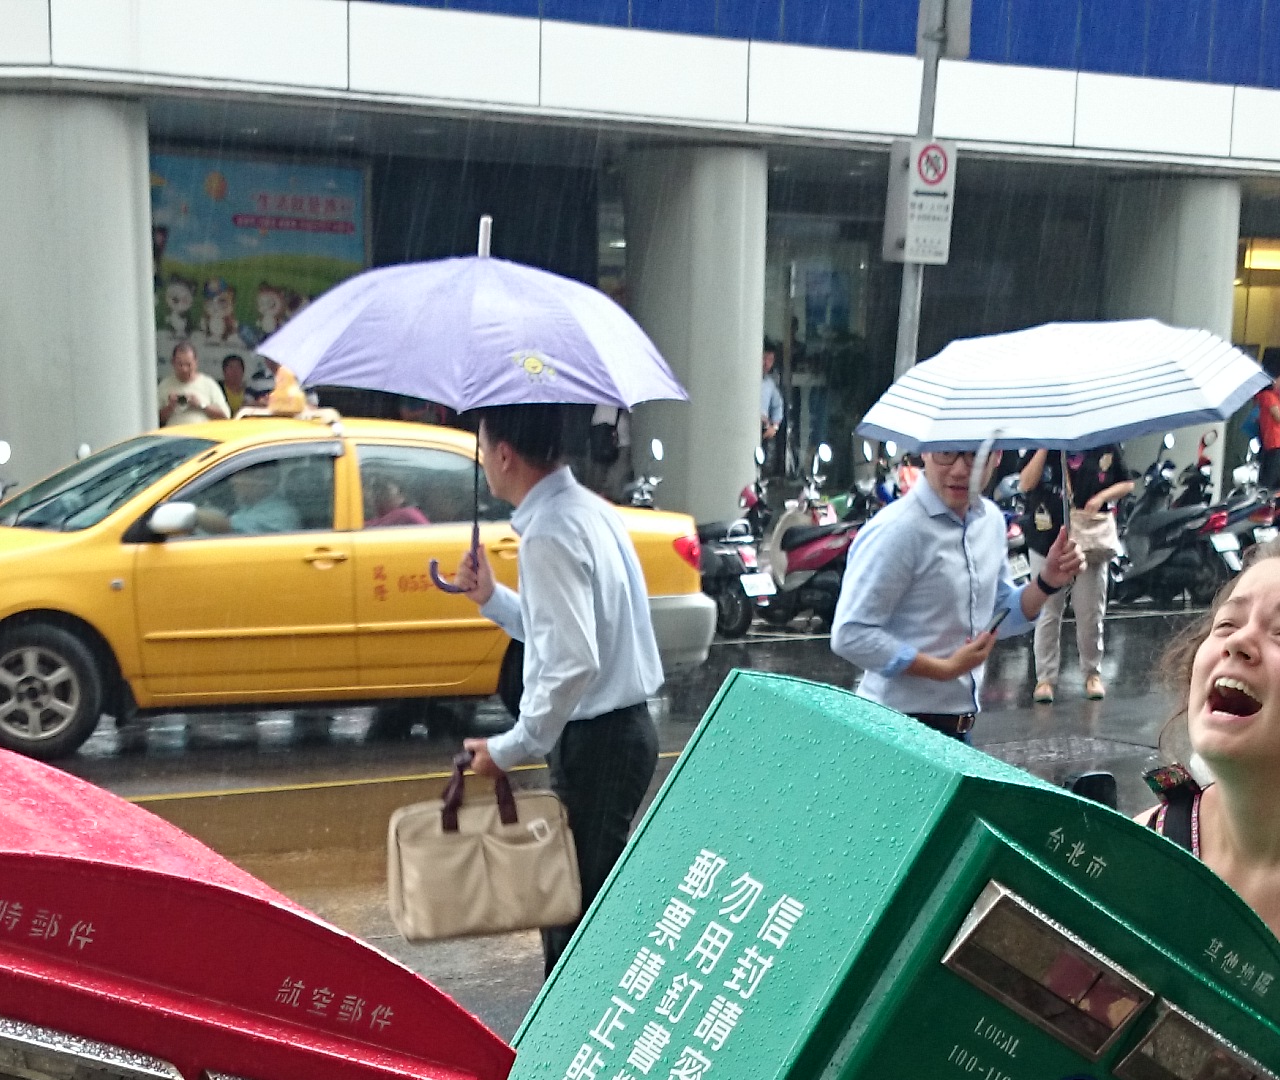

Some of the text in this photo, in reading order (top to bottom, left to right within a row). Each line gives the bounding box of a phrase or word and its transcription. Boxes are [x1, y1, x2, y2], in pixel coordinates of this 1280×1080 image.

[1046, 827, 1109, 880] 台北市
[1204, 936, 1274, 997] 其他地區
[275, 977, 394, 1031] 航空郵件
[975, 1015, 1021, 1058] LOCAL
